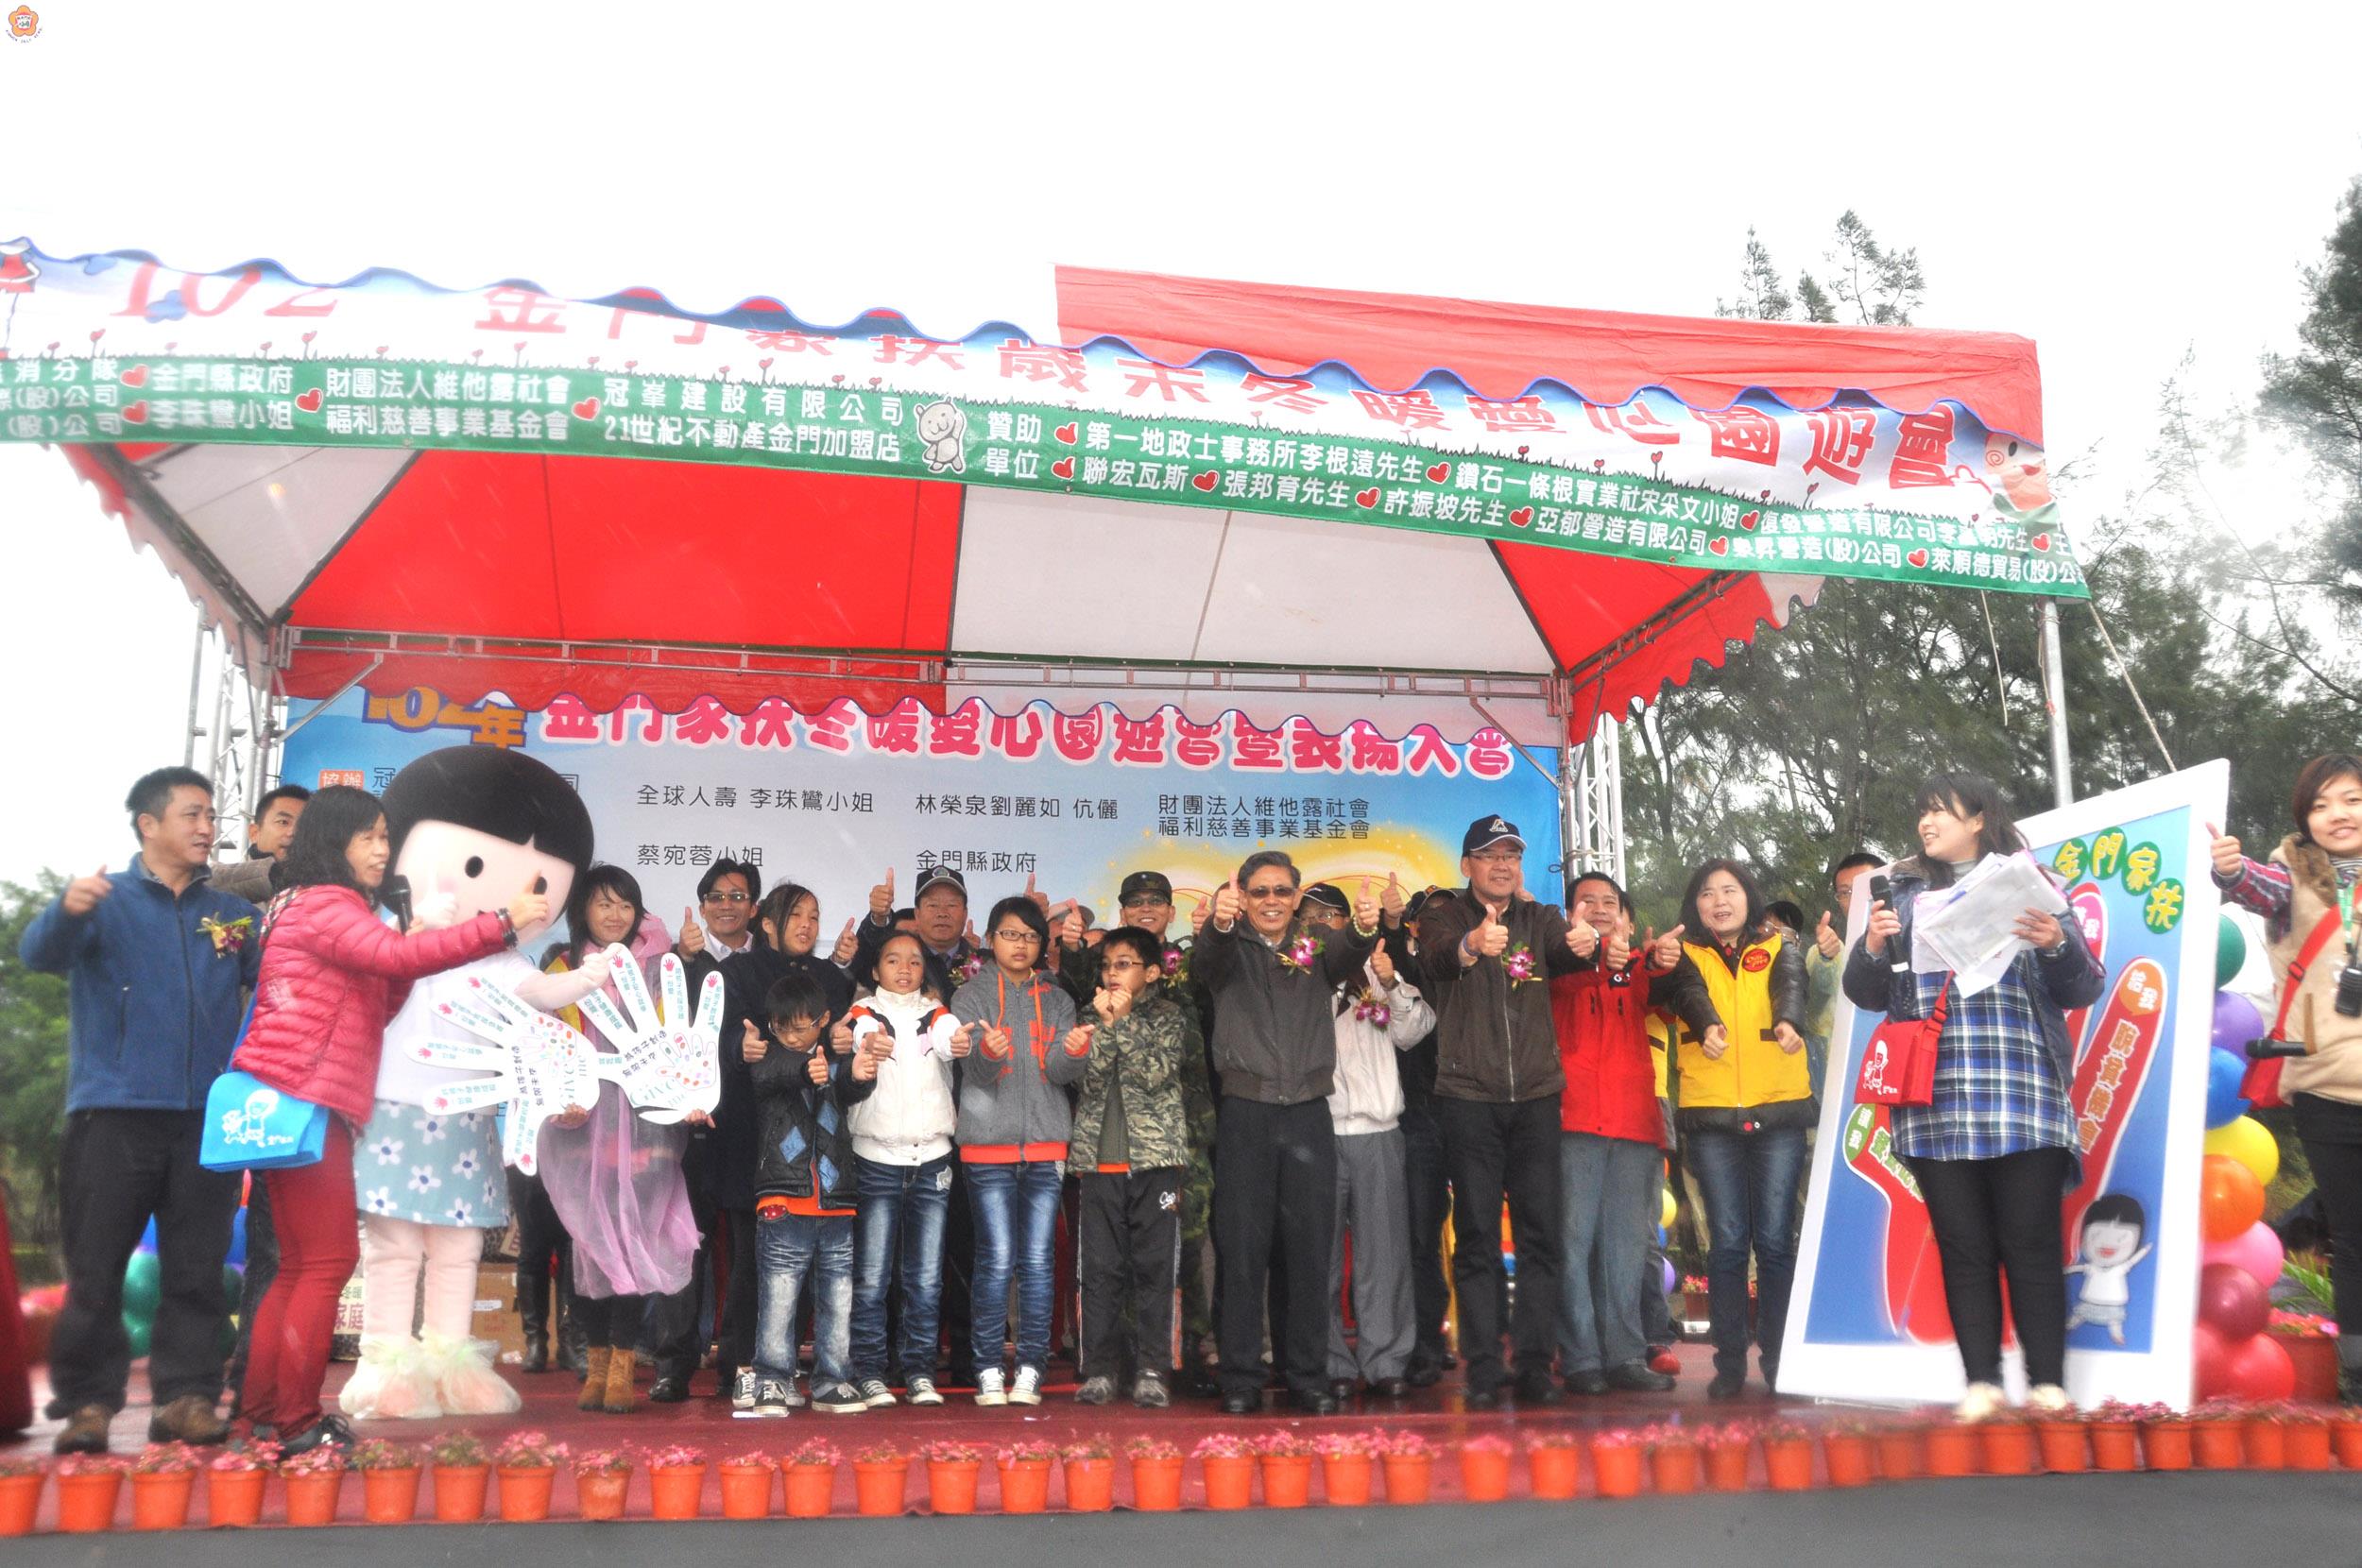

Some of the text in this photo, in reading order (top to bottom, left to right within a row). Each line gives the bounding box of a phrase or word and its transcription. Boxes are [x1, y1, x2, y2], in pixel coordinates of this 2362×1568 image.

[0, 360, 118, 383] 消分隊
[152, 364, 293, 394] 金門縣政府
[325, 367, 571, 405] 財團法人維他露社會
[326, 403, 569, 441] 福利慈善事業基金會
[604, 414, 901, 463] 21世紀不動產金門加盟店
[1086, 420, 1424, 486] 第一地政士事務所李根遠先生
[984, 447, 1040, 479] 單位
[1082, 455, 1189, 493] 聯宏瓦斯
[1223, 471, 1350, 511] 張邦育先生
[1384, 487, 1507, 528] 許振坡先生
[637, 784, 874, 813] 全球人壽 李珠鸞小姐
[915, 793, 1119, 820] 林榮泉劉麗如 伉儷
[1158, 794, 1369, 818] 財團法人維他露社會
[1158, 815, 1369, 840] 福利慈善事業基金會
[637, 844, 764, 867] 蔡宛蓉小姐
[916, 849, 1037, 873] 金門縣政府
[2055, 828, 2182, 929] 金門家扶
